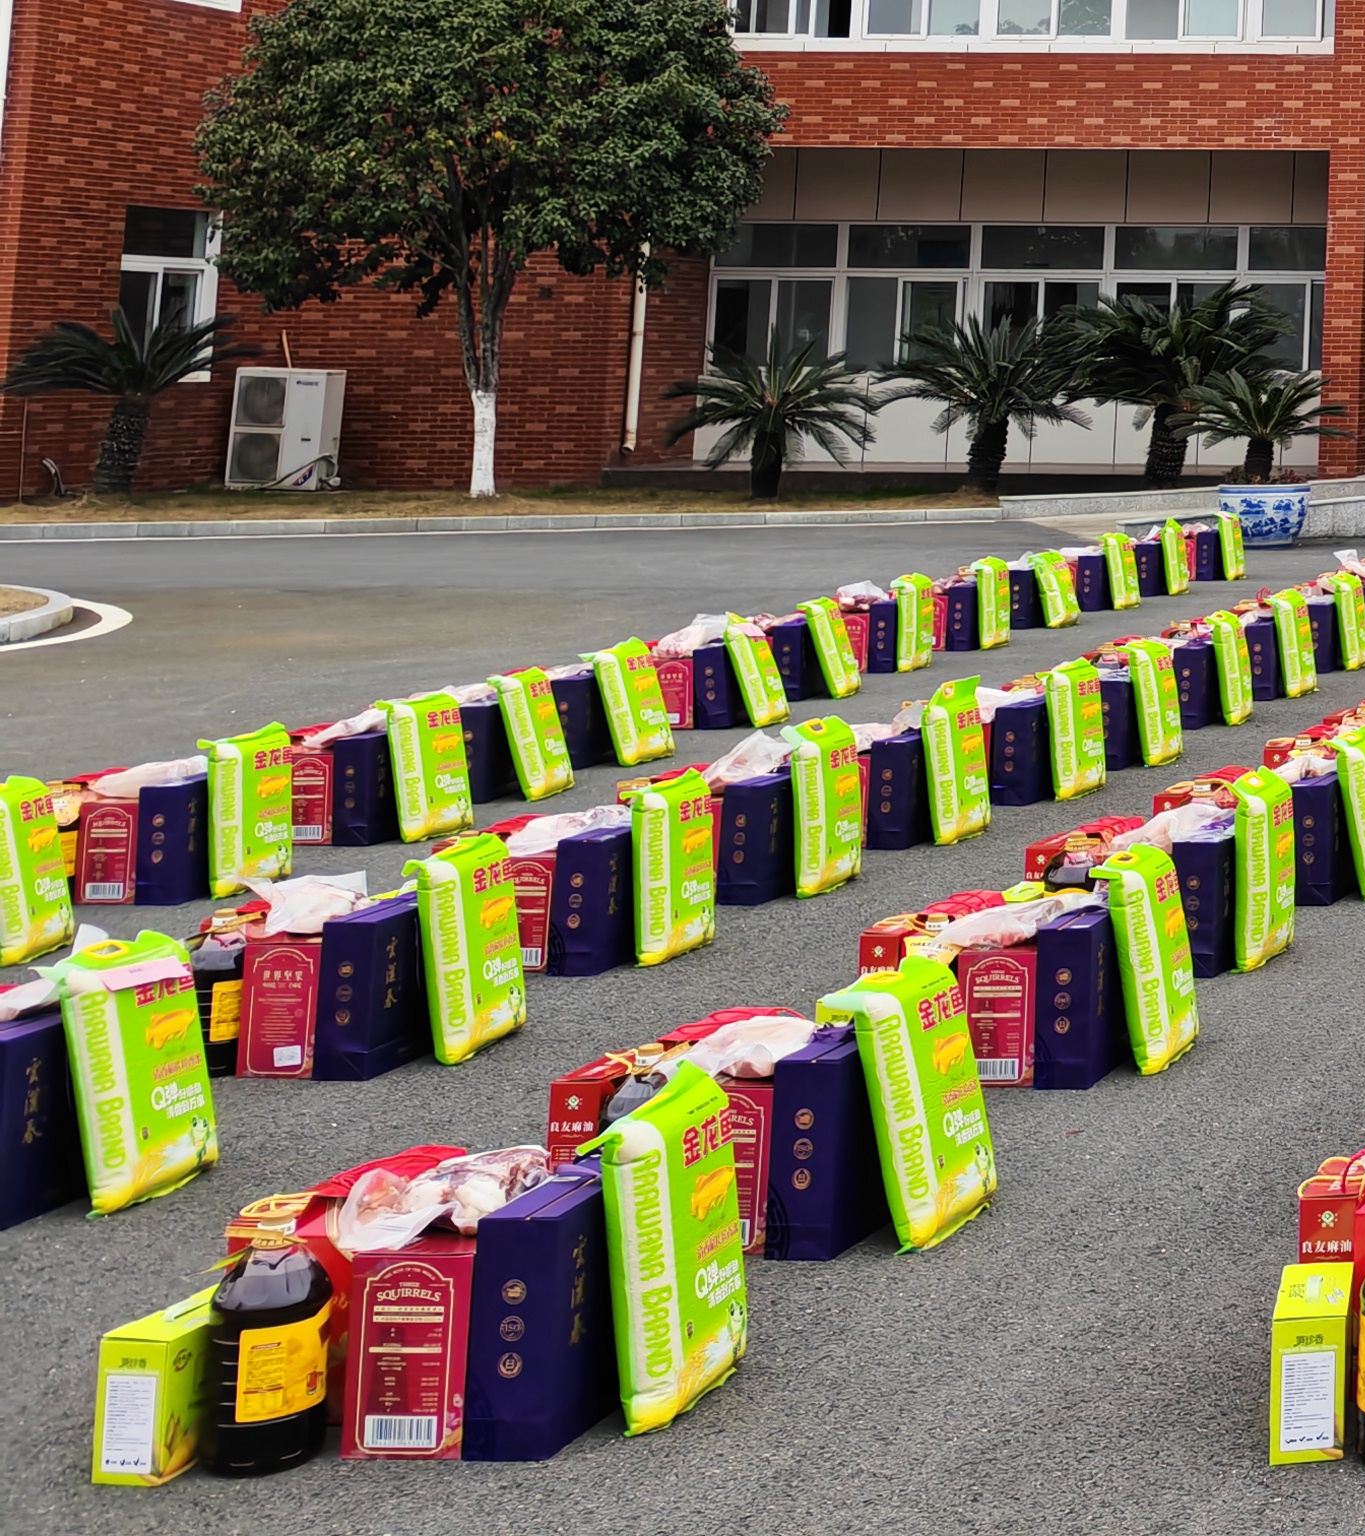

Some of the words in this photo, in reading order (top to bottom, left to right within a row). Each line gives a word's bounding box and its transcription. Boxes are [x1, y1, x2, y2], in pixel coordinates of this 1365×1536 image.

[254, 746, 293, 770] 金龙鱼
[678, 795, 712, 823] 金龙鱼
[473, 857, 514, 894] 金龙鱼
[975, 971, 1021, 984] SQUIRRELS
[917, 984, 966, 1032] 金龙鱼
[682, 1107, 733, 1168] 金龙鱼
[1302, 1240, 1353, 1254] 良友麻油
[376, 1287, 443, 1302] SQUIRRELS
